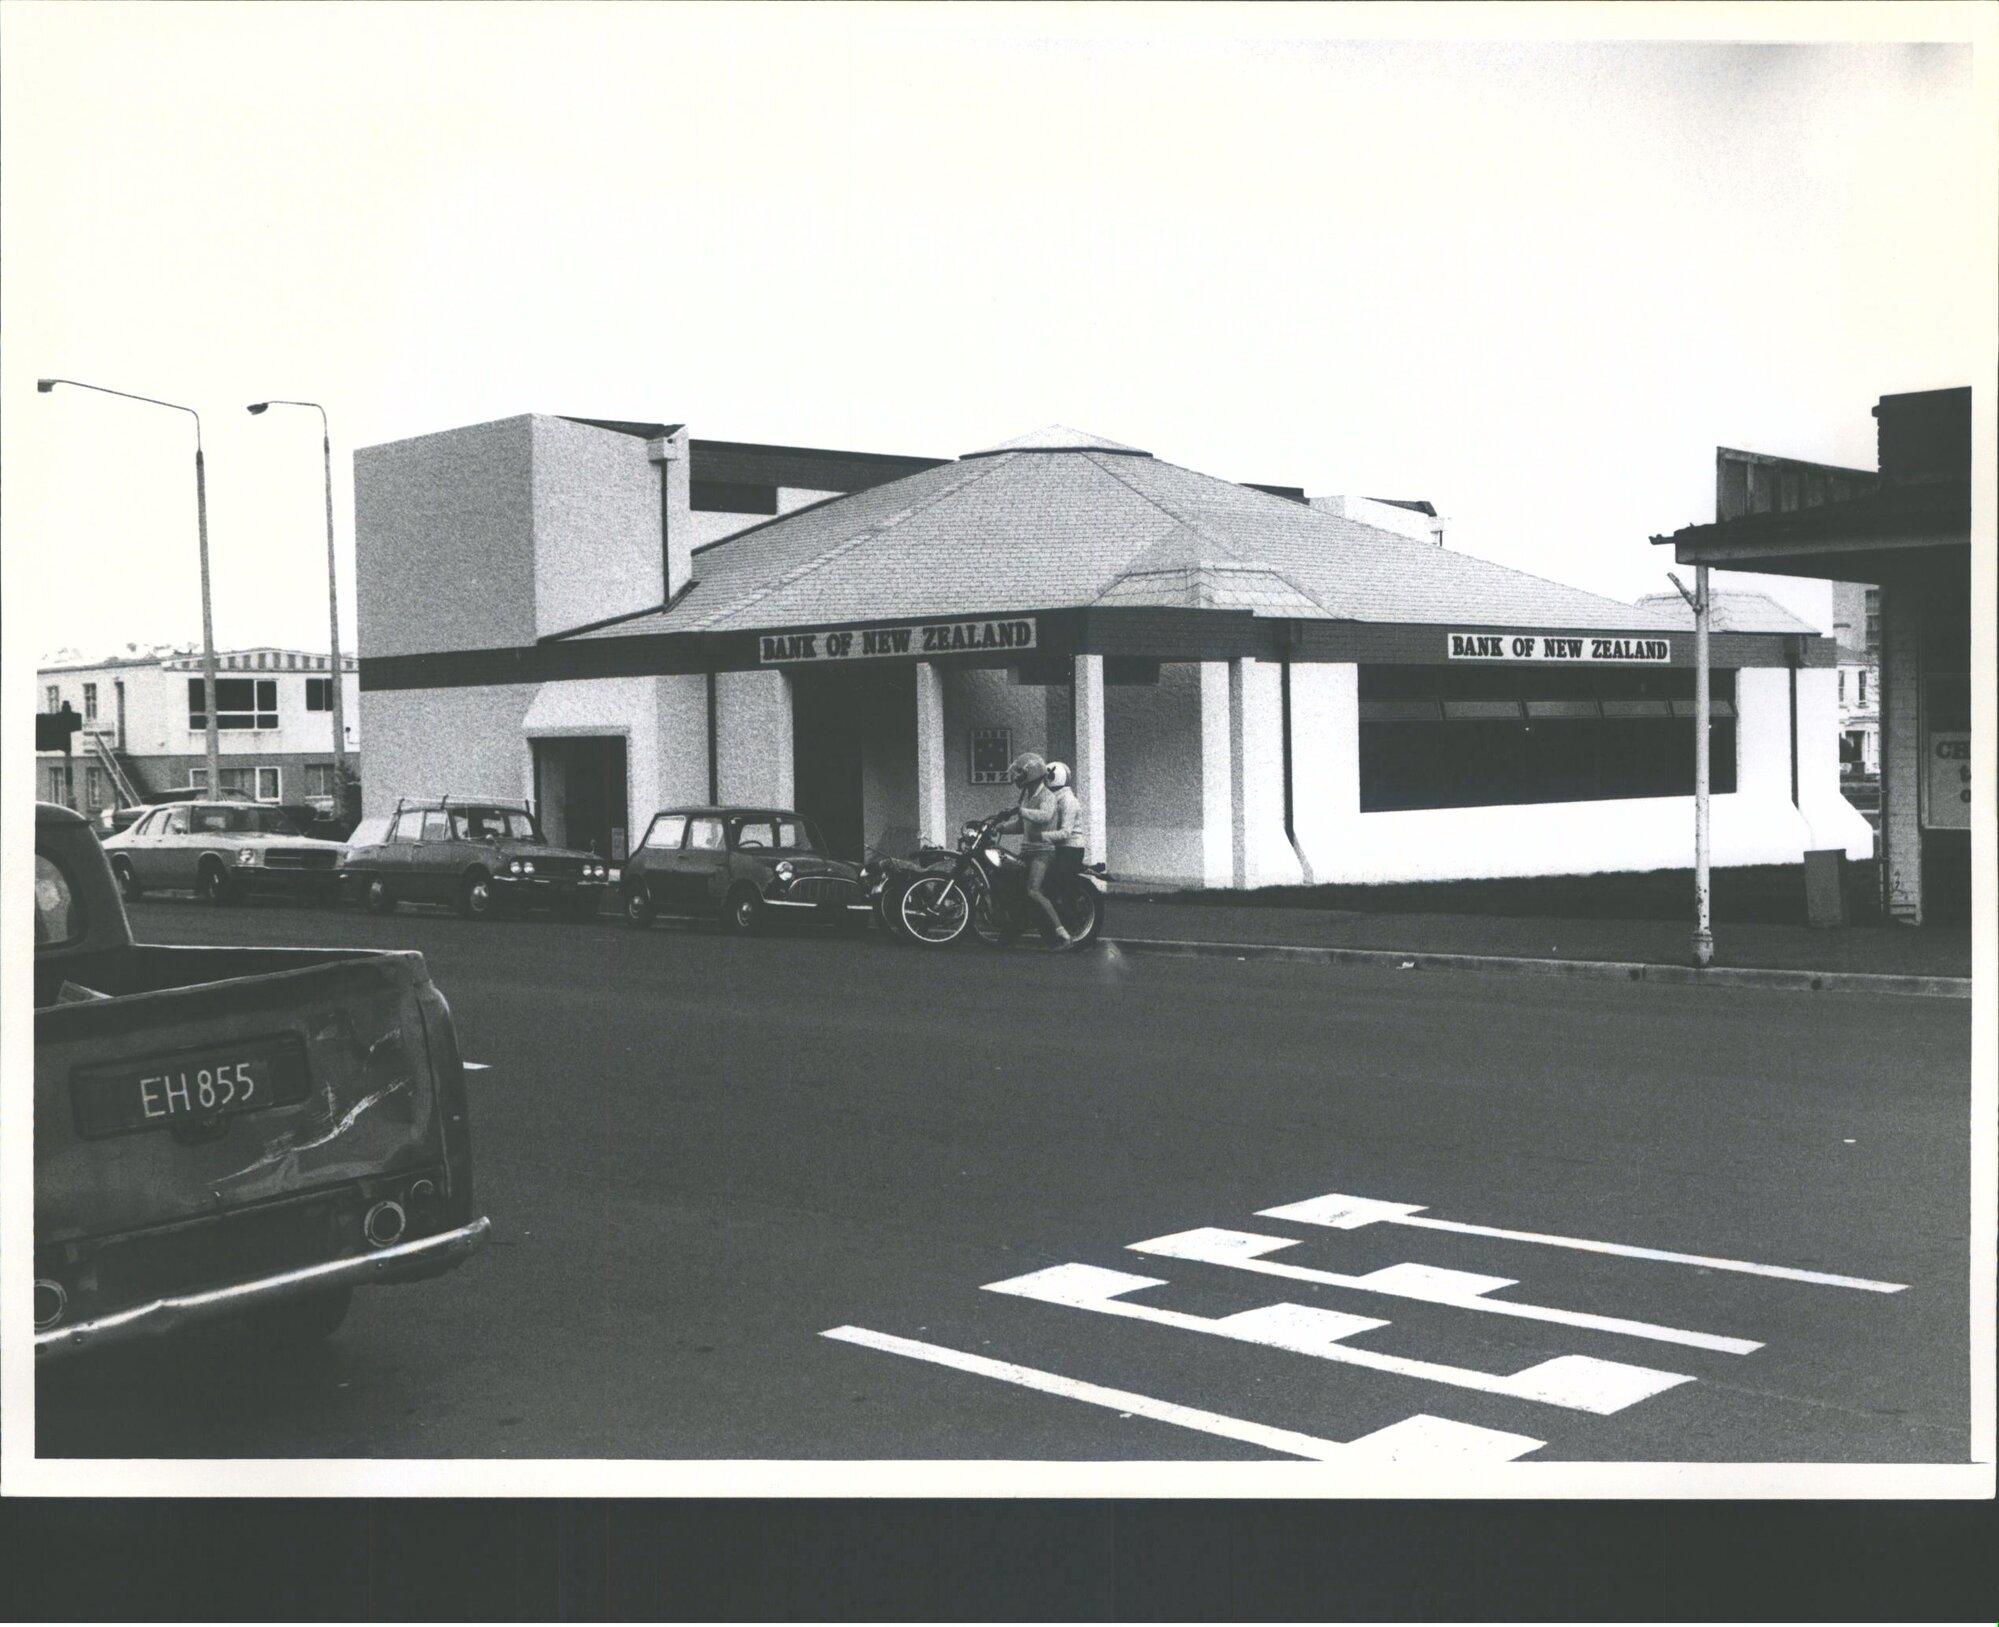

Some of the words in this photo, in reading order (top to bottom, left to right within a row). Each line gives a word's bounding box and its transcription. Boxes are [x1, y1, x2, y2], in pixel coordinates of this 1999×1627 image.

[762, 635, 817, 661] BANK
[825, 632, 853, 657] OF
[861, 629, 913, 655] NEW
[921, 621, 1032, 651] ZEALAND
[1452, 636, 1504, 657] BANK
[1512, 637, 1535, 658] OF
[1543, 638, 1583, 659] NEW
[1591, 639, 1668, 660] ZEALAND
[974, 772, 1009, 782] BNZ
